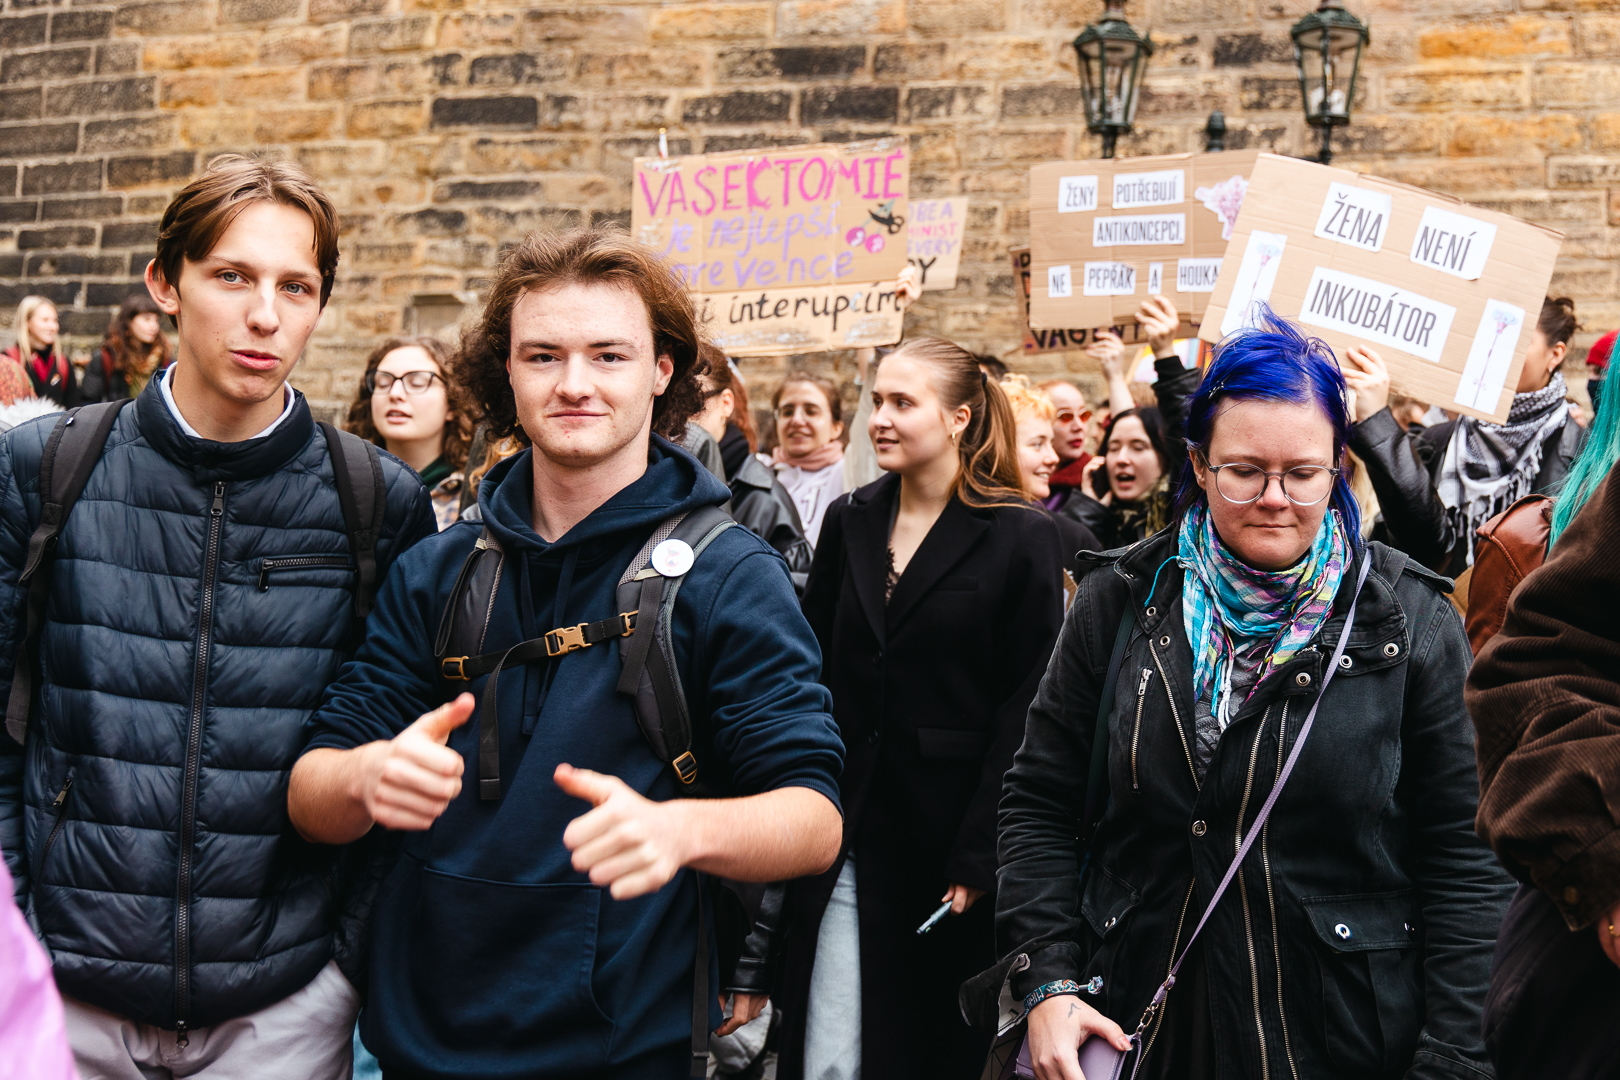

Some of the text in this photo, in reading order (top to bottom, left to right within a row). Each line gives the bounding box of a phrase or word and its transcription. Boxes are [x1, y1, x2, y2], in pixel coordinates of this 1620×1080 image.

[1066, 175, 1177, 207] ŽENY POTŘEBUJÍ
[1323, 191, 1477, 272] ŽENA NENÍ
[1051, 273, 1067, 293] NE
[1150, 268, 1159, 289] A
[1309, 278, 1438, 348] INKUBÁTOR
